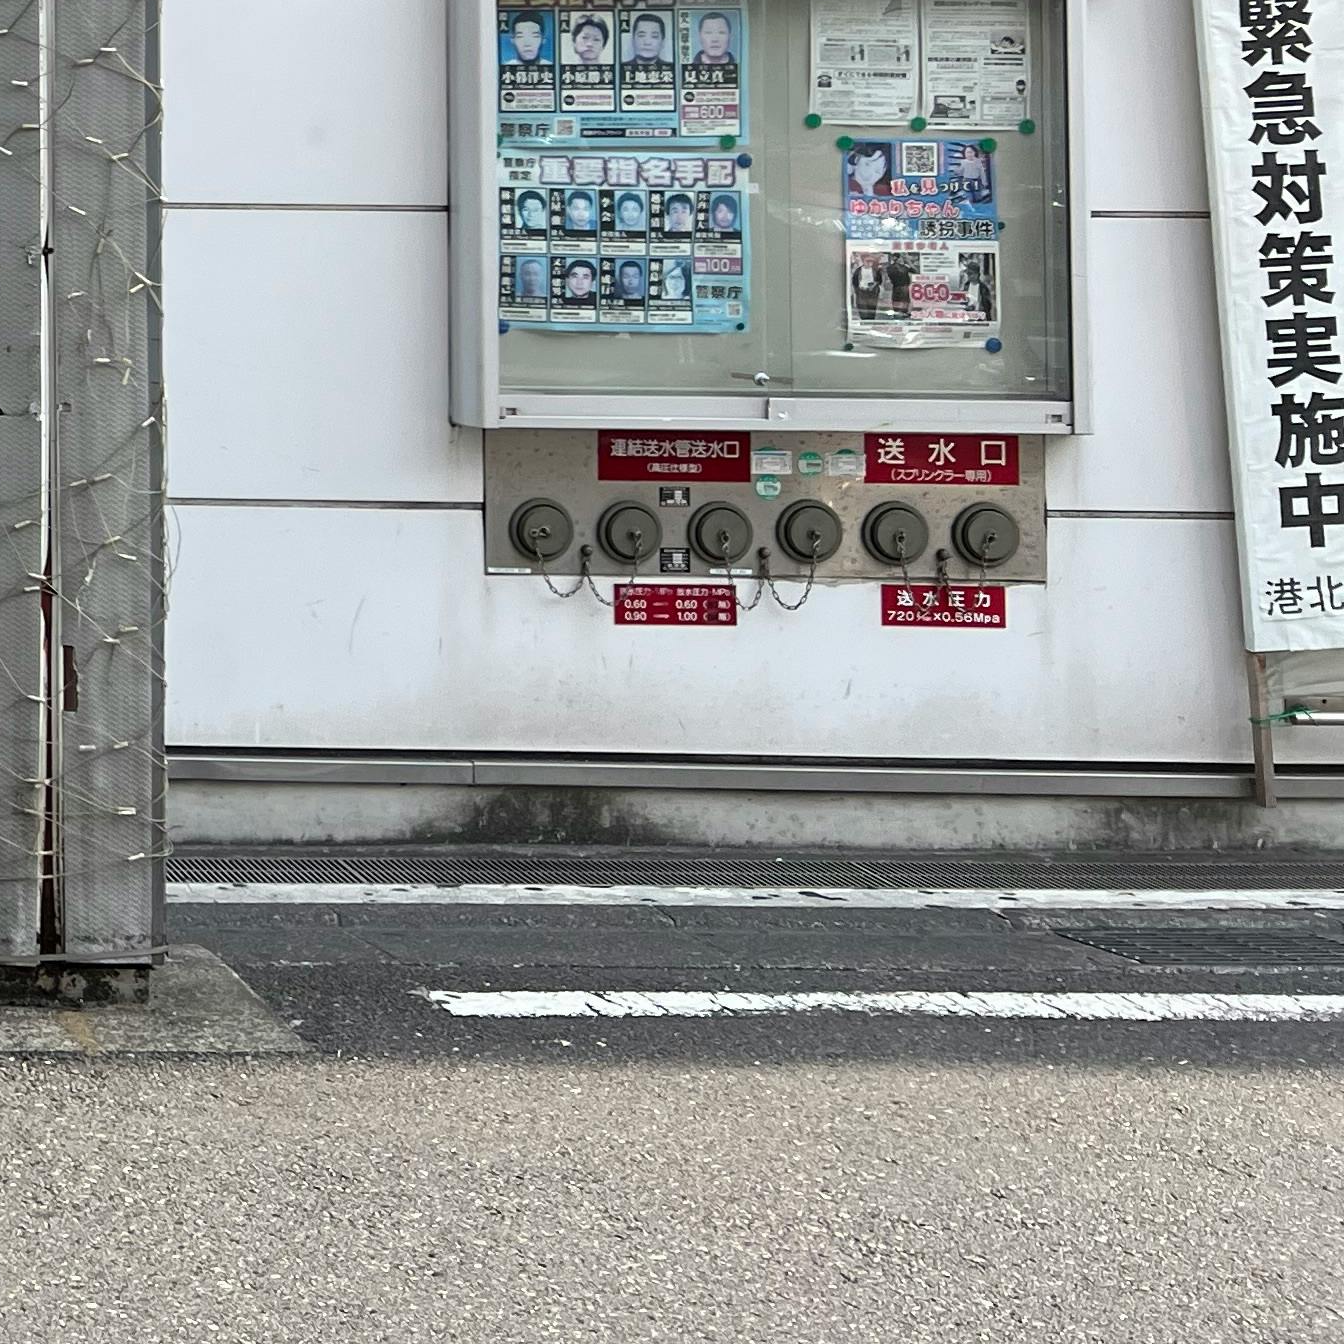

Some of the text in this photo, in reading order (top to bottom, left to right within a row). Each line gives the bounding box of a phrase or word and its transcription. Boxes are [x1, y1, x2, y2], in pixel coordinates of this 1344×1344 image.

[700, 105, 725, 120] 600
[539, 156, 736, 187] 重要指名手配
[849, 199, 961, 219] ゆかりちゃん
[610, 438, 740, 458] 連結送水管送水口
[877, 437, 1007, 467] 送水口
[624, 599, 647, 610] 0.60
[675, 599, 698, 611] 0.60
[896, 589, 991, 608] 送水圧力
[1264, 575, 1344, 617] 港北
[676, 611, 698, 622] 1.00
